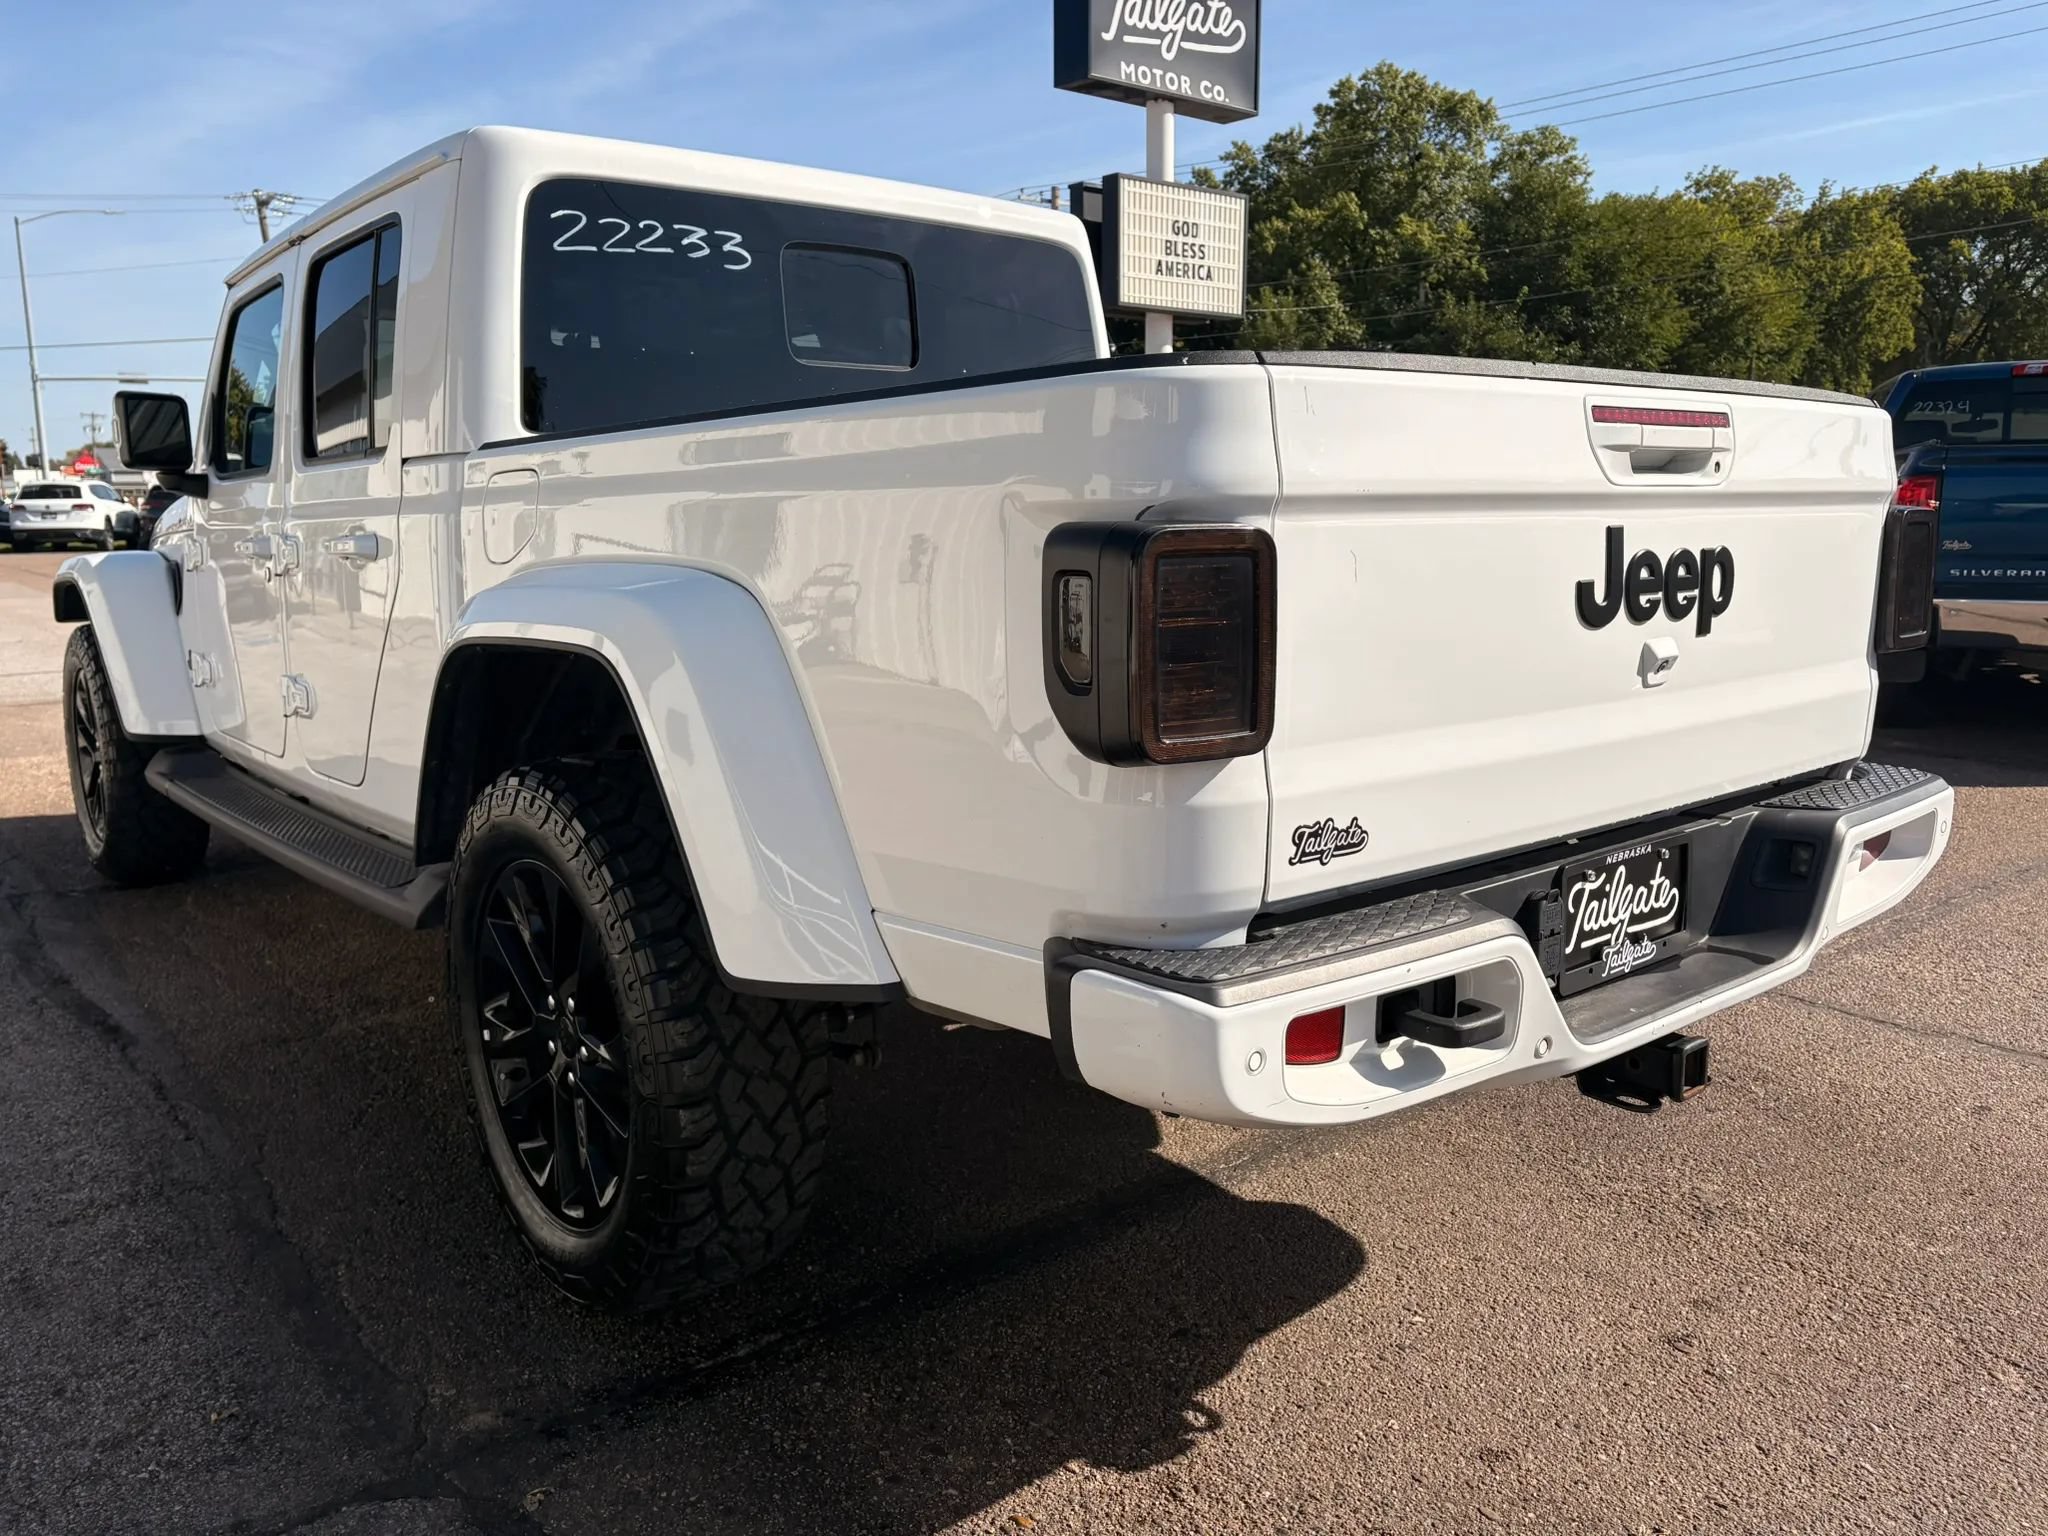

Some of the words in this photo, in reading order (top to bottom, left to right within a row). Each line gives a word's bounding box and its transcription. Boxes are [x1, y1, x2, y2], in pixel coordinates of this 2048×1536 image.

[1120, 60, 1192, 95] MOTOR
[1199, 80, 1230, 103] CO.
[550, 209, 751, 270] 22233
[1165, 239, 1206, 260] BLESS
[1172, 219, 1199, 238] GOD
[1155, 259, 1213, 281] AMERICA
[1911, 400, 1970, 415] 22324
[1575, 525, 1735, 637] Jeep
[1289, 816, 1369, 866] Tailgate
[1605, 844, 1652, 865] NEBRASKA
[1565, 861, 1679, 955] Tailgate
[1602, 933, 1657, 977] Tailgate
